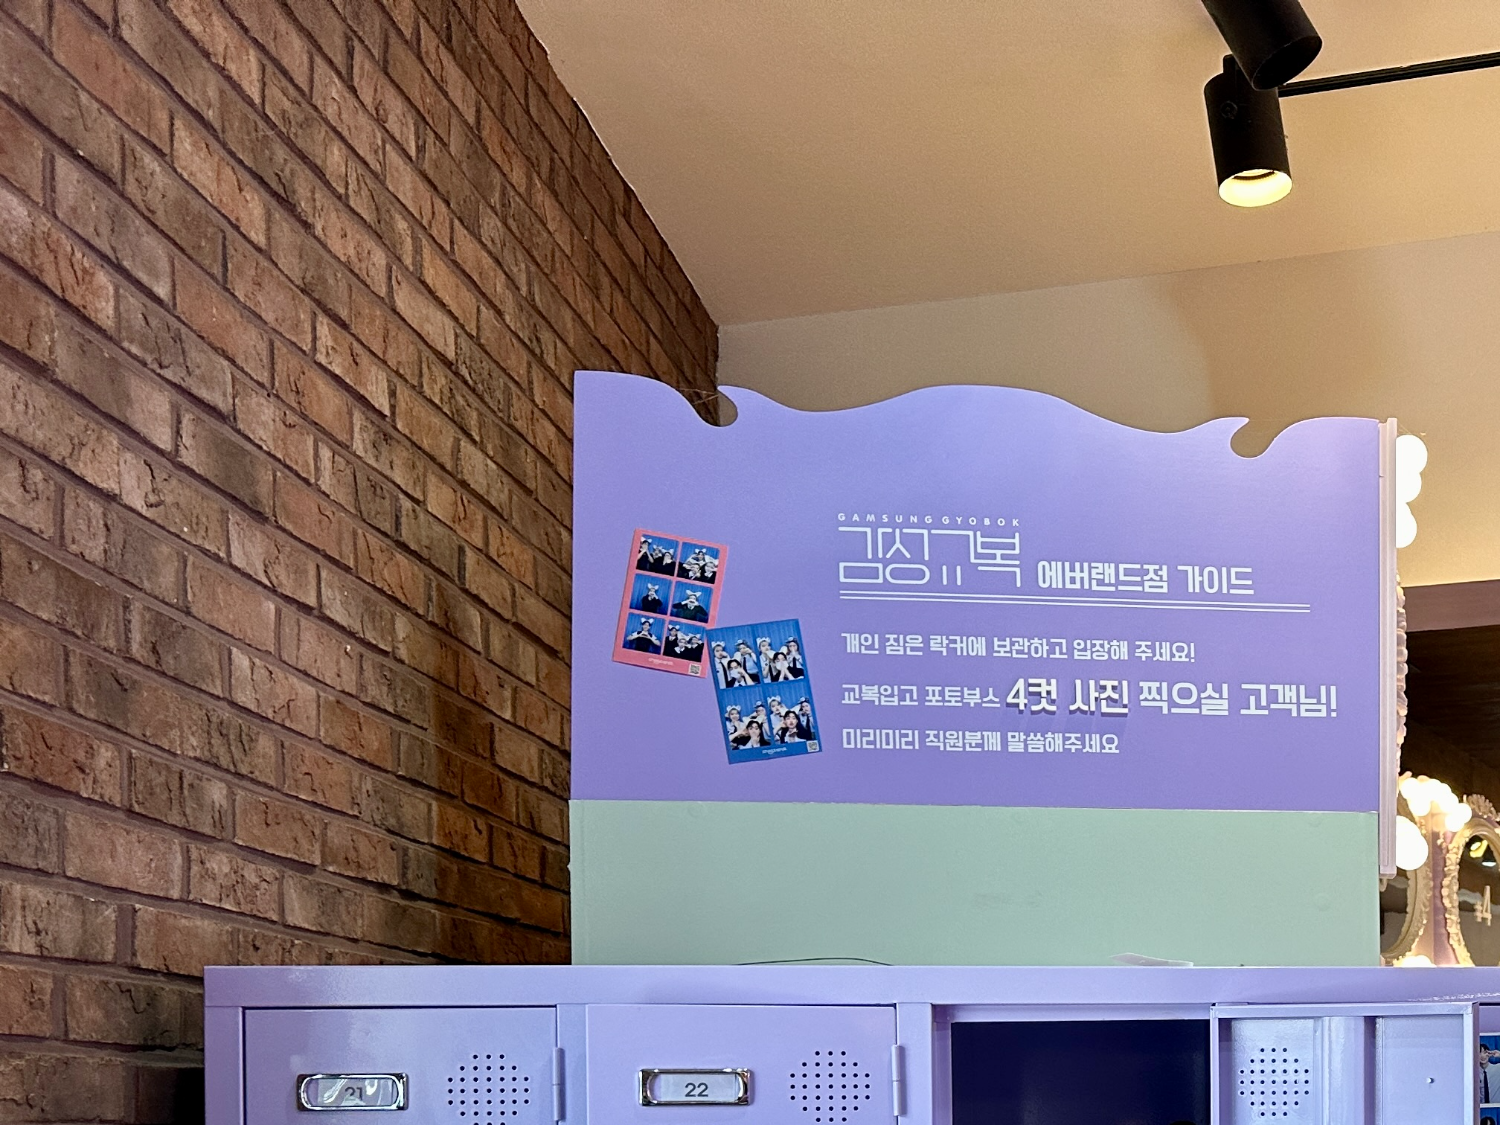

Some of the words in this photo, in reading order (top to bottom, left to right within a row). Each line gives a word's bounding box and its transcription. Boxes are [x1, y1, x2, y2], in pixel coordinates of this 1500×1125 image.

[838, 513, 932, 524] GAMSUNG
[942, 516, 1019, 527] GYOBOK
[1037, 560, 1168, 593] 에버랜드점
[1177, 565, 1255, 594] 가이드
[841, 633, 879, 654] 개인
[885, 634, 924, 655] 짐은
[929, 635, 986, 656] 락커에
[993, 637, 1067, 659] 보관하고
[1073, 639, 1128, 660] 입장해
[1135, 641, 1195, 662] 주세요!
[841, 684, 918, 706] 교복입고
[925, 685, 1000, 707] 포토부스
[1005, 678, 1057, 713] 4컷
[1069, 679, 1129, 714] 사진
[1139, 681, 1229, 715] 찍으실
[1240, 683, 1337, 717] 고객님!
[842, 728, 919, 749] 미리미리
[925, 730, 1001, 751] 직원분께
[1007, 731, 1120, 753] 말씀해주세요
[345, 1087, 363, 1101] 21
[684, 1083, 708, 1097] 22
